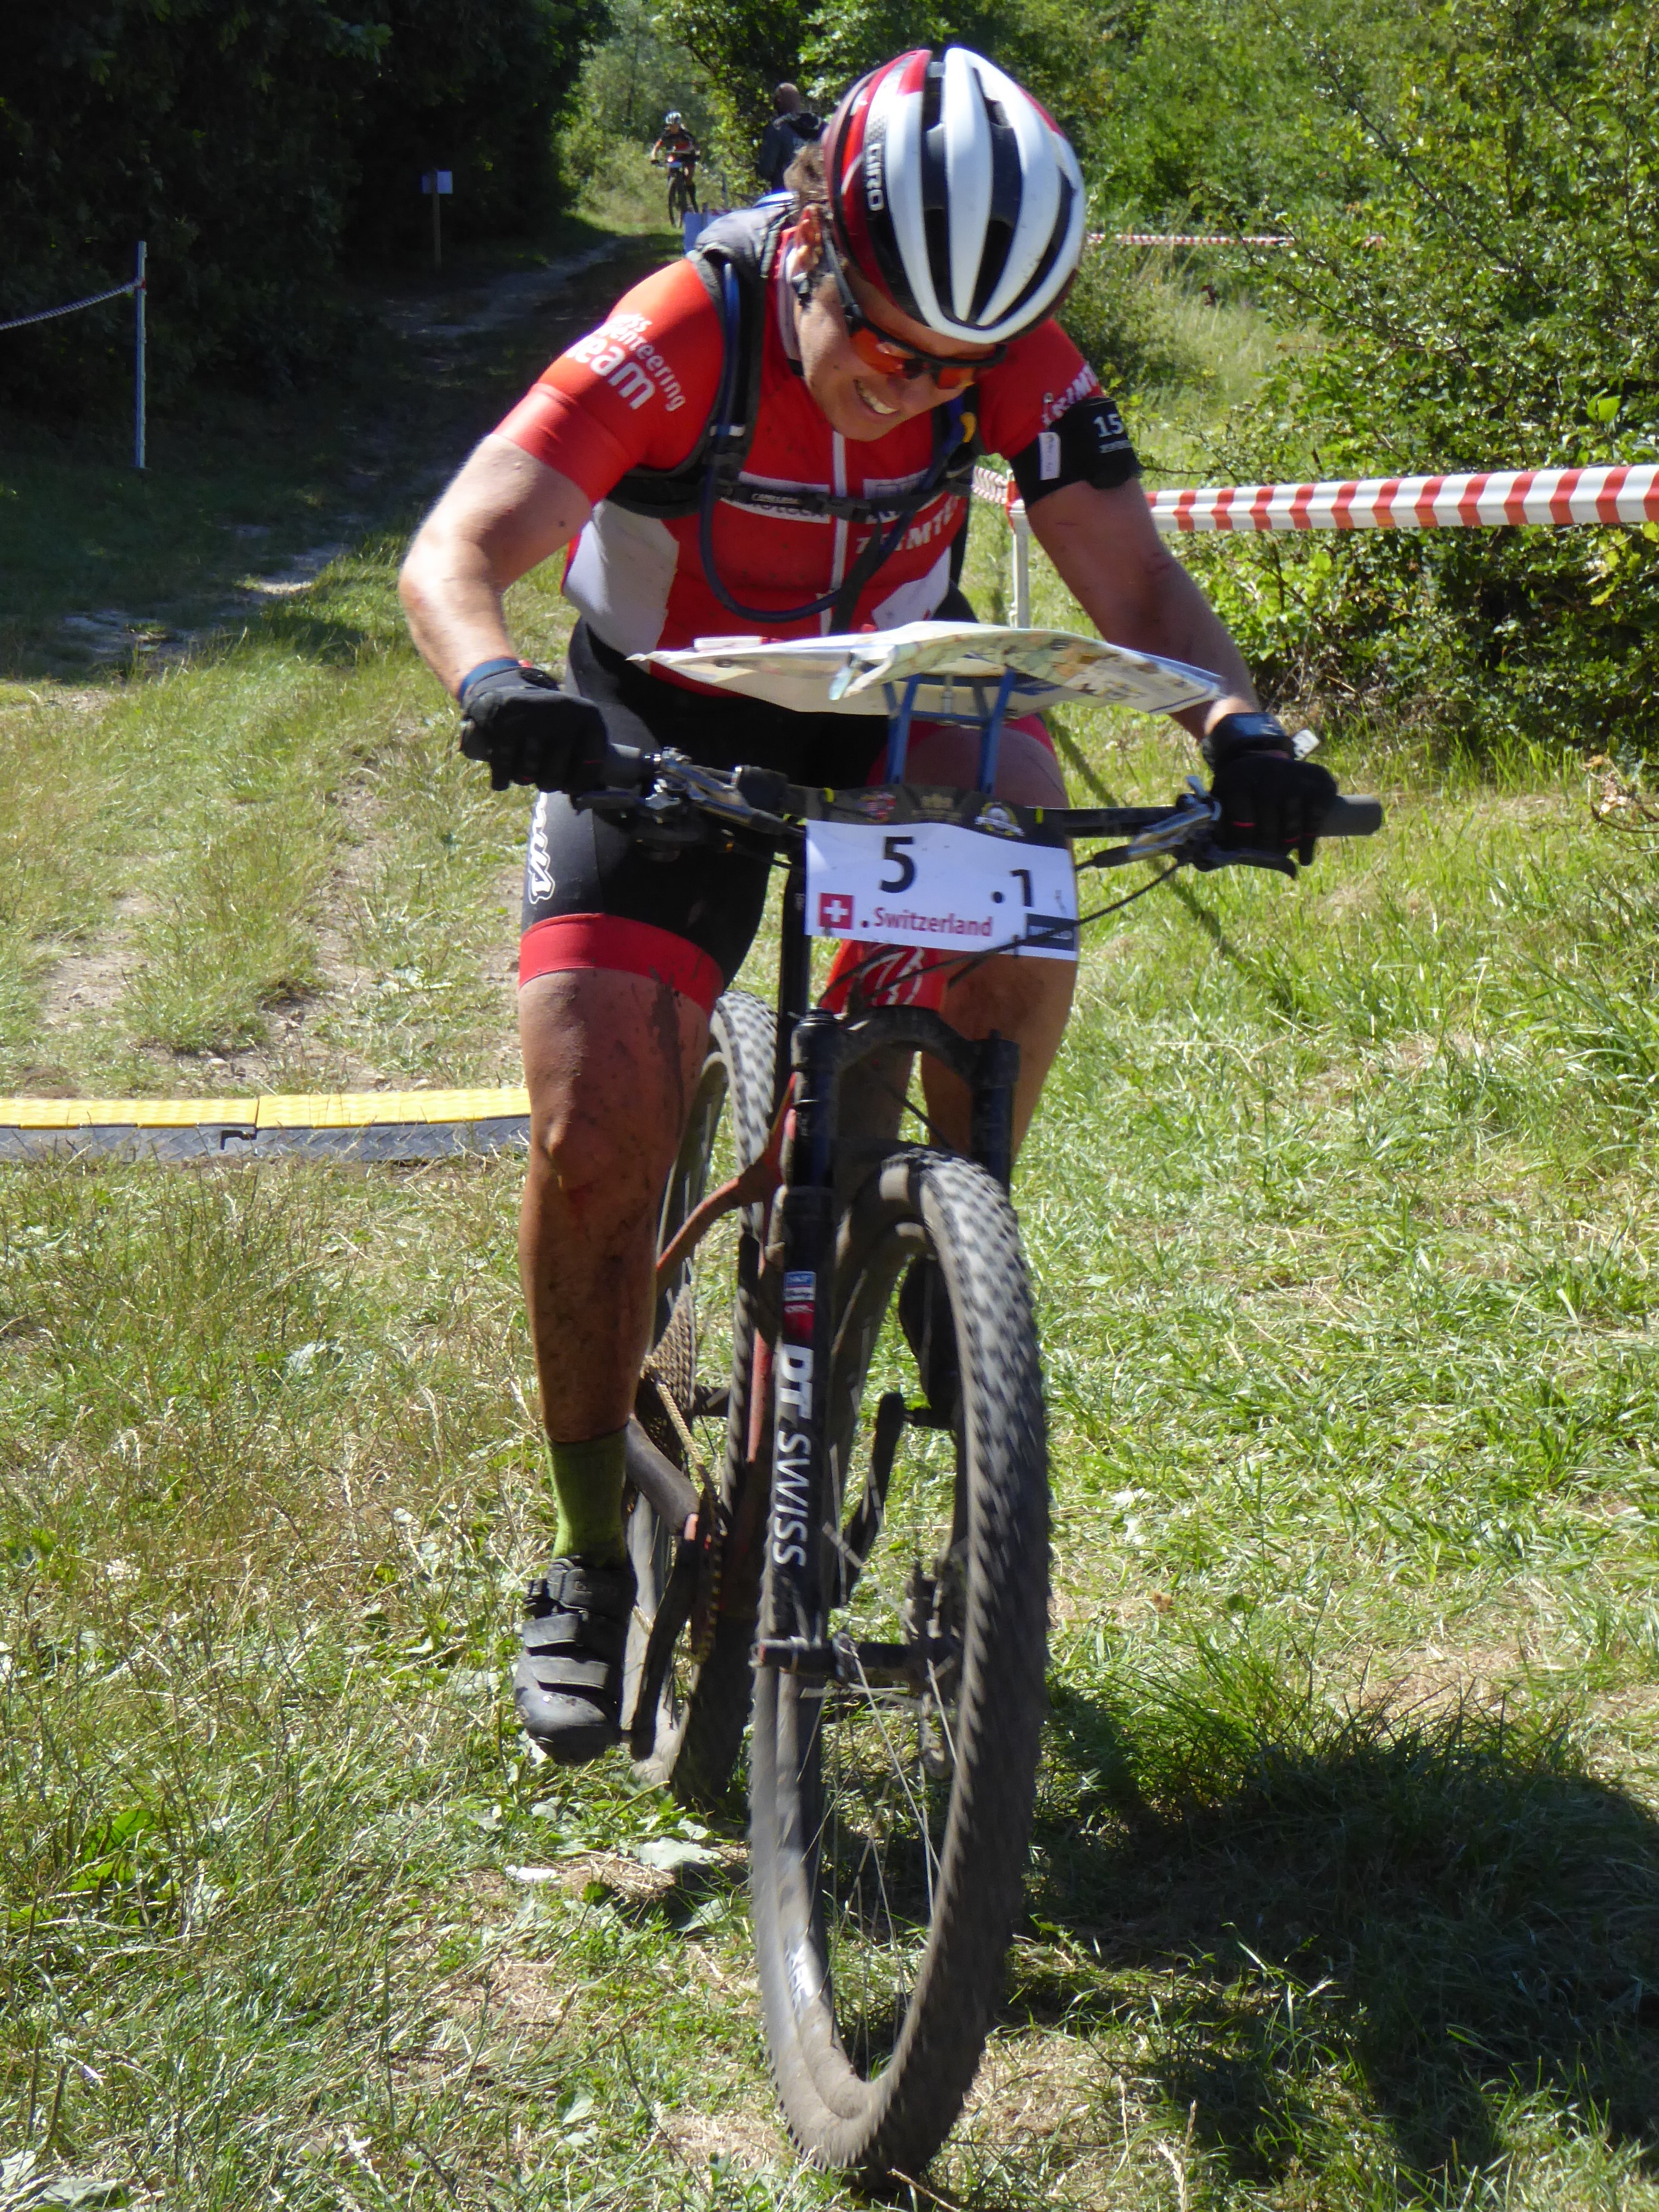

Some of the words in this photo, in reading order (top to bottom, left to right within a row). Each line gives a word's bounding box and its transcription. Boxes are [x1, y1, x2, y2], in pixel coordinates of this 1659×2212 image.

[867, 143, 883, 212] GIRO
[1093, 413, 1125, 438] 15
[880, 836, 917, 894] 5
[873, 907, 993, 937] Switzerland
[781, 1344, 814, 1420] DT
[772, 1430, 812, 1567] SWISS
